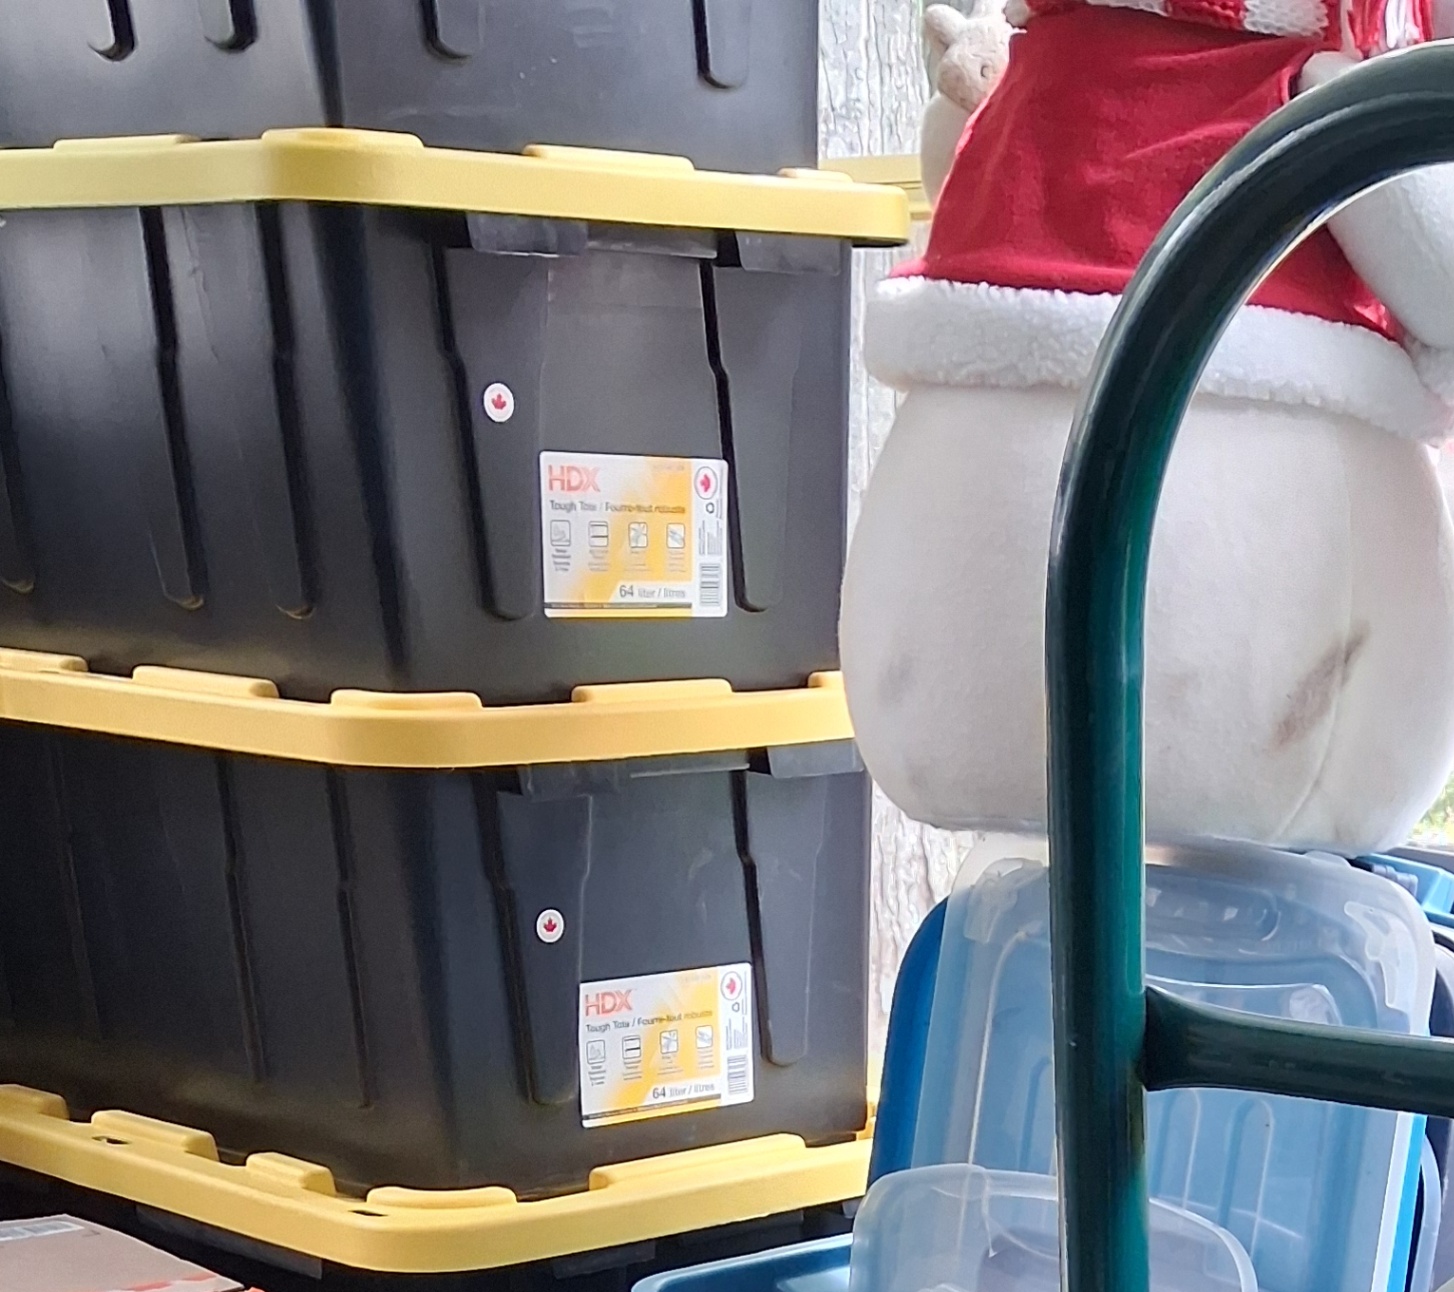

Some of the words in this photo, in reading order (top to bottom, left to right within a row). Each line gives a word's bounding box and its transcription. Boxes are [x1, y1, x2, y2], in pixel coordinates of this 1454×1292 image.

[547, 464, 600, 492] HDX
[619, 584, 634, 598] 64
[584, 989, 634, 1017] HDX
[652, 1086, 666, 1099] 64
